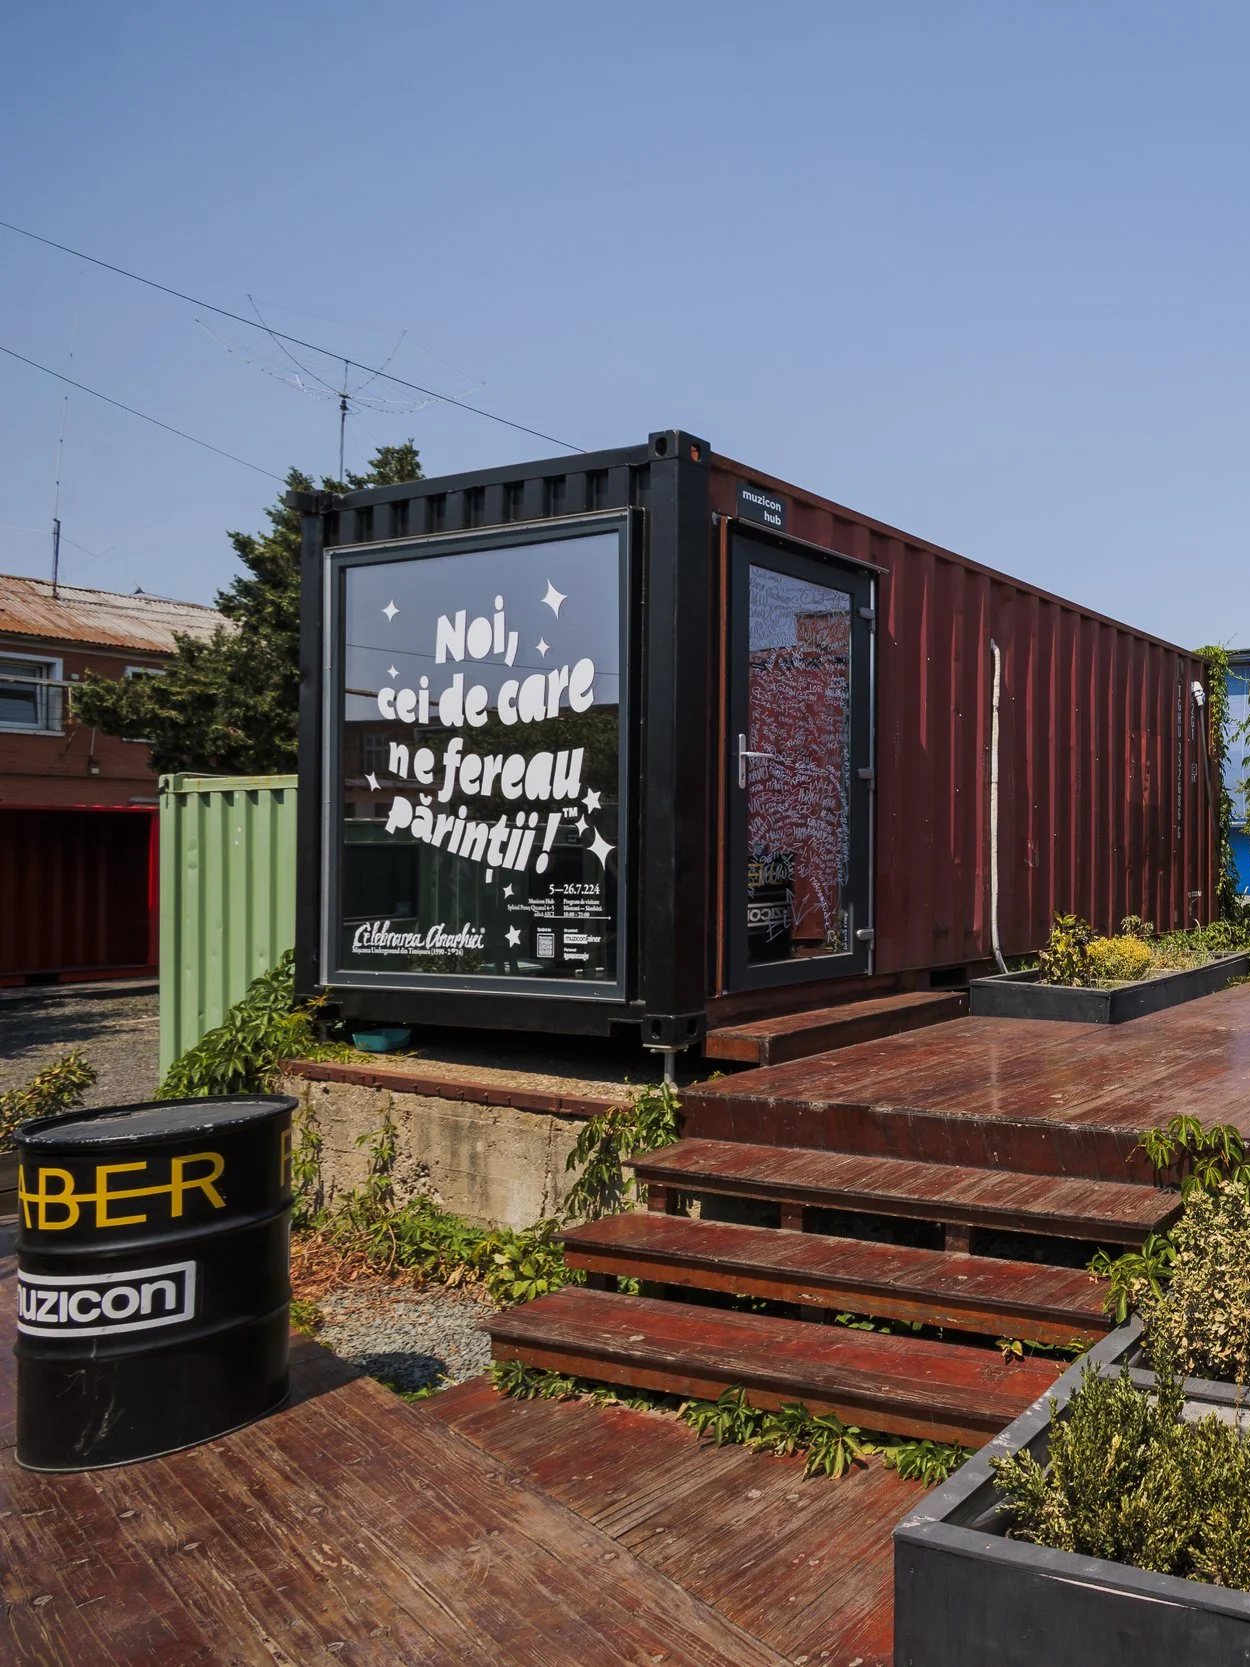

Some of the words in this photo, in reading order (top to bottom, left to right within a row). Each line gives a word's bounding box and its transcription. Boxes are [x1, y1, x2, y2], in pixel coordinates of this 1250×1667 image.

[742, 490, 782, 512] muzicon
[764, 510, 782, 526] hub
[435, 595, 518, 667] Noi,
[377, 675, 429, 724] cei
[438, 673, 489, 727] de
[497, 657, 595, 726] care
[388, 741, 435, 785] ne
[438, 737, 585, 803] fereau
